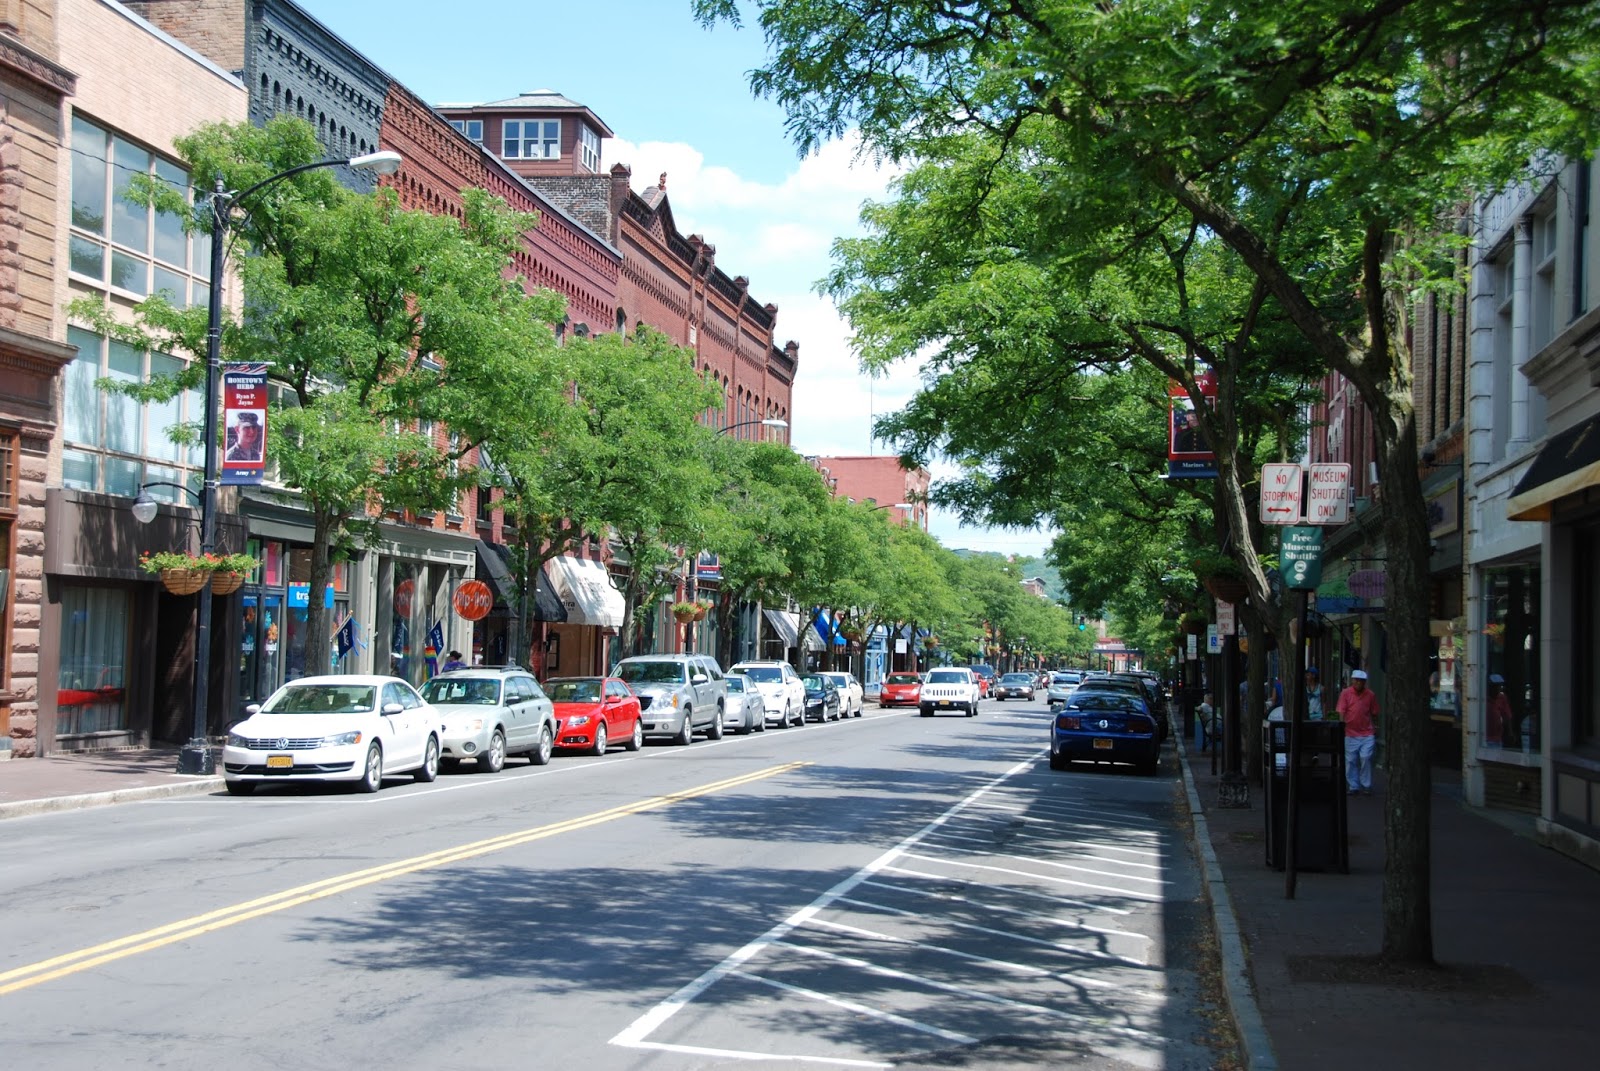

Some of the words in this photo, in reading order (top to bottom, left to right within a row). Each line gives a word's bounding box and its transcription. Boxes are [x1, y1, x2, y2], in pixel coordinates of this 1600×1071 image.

[235, 393, 250, 401] Ryan
[1275, 474, 1287, 485] NO
[1312, 471, 1346, 483] MUSEUM
[1263, 491, 1298, 502] STOPPING
[1311, 488, 1346, 500] SHUTTLE
[1317, 505, 1338, 517] ONLY
[1292, 533, 1312, 542] Free
[1282, 542, 1321, 551] Museum
[1284, 551, 1318, 561] Shuttle
[457, 592, 490, 610] flip-flop
